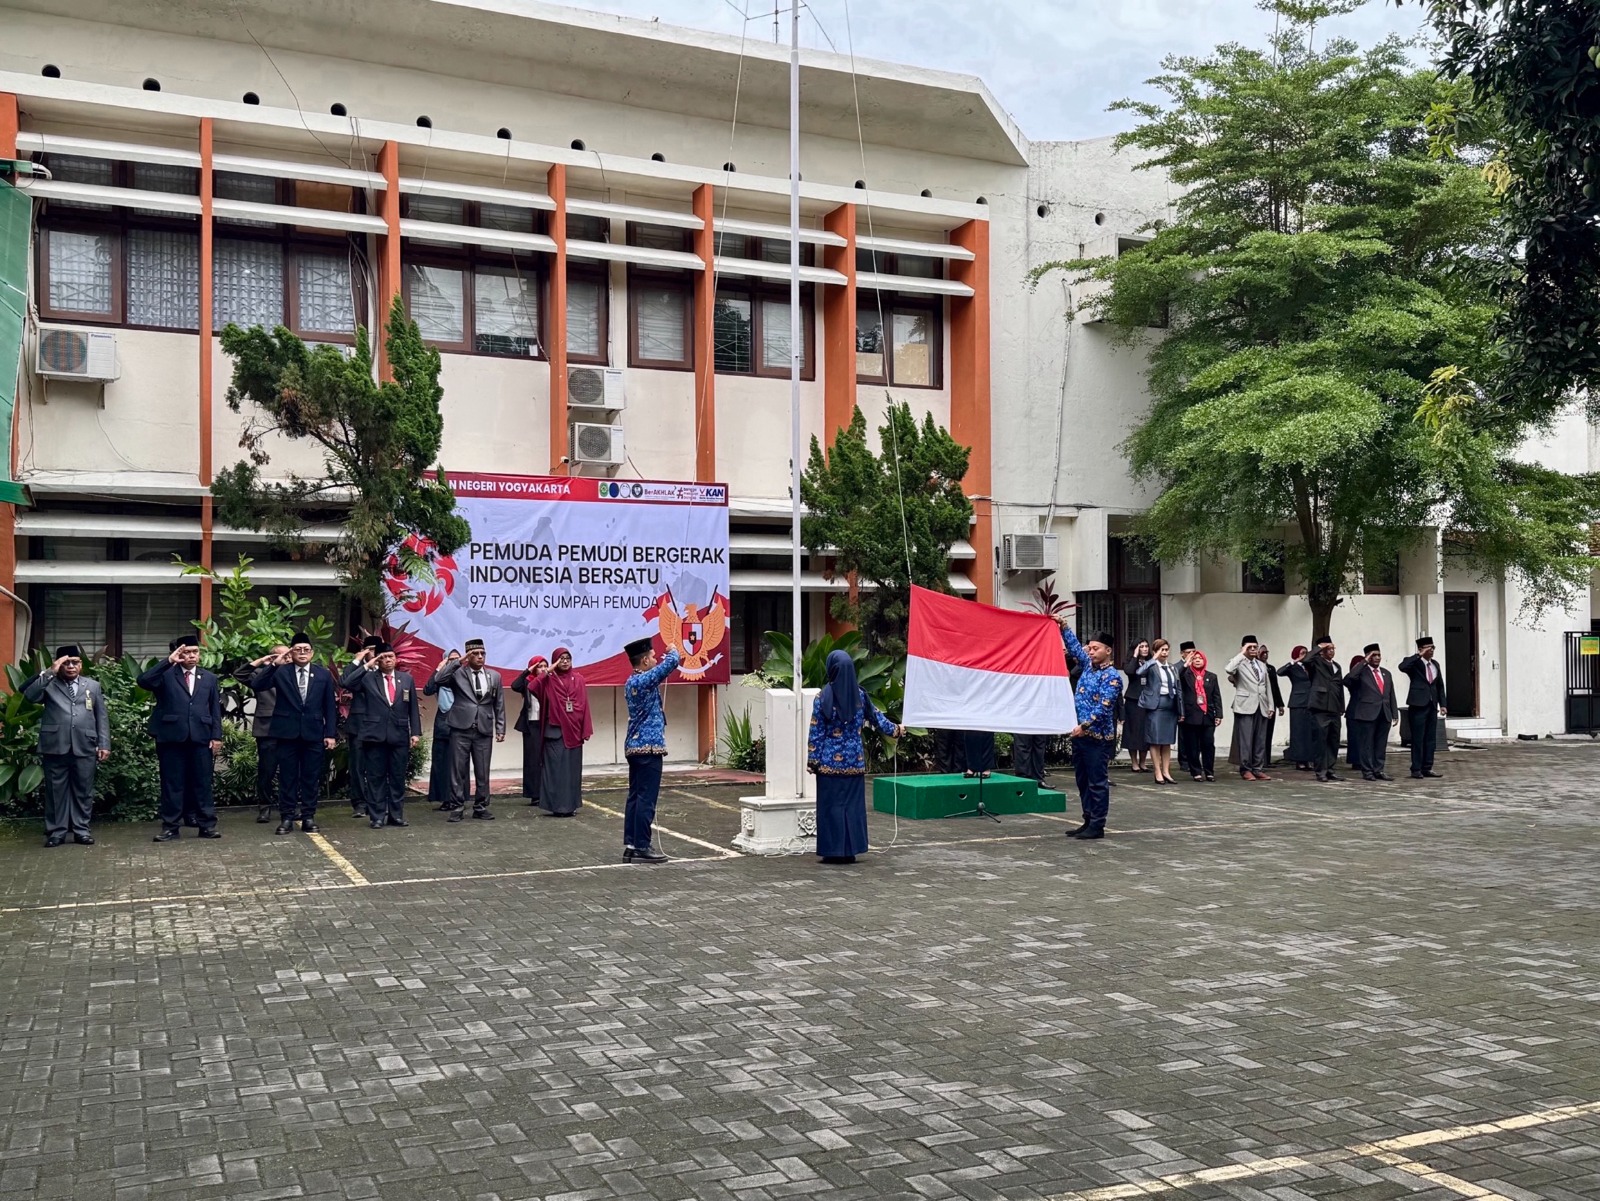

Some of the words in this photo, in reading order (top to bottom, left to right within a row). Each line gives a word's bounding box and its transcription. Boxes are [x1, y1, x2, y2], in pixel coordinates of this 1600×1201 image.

[459, 480, 496, 491] NEGERI
[499, 482, 571, 494] YOGYAKARTA
[705, 488, 724, 497] KAN
[470, 543, 552, 561] PEMUDA
[558, 545, 627, 562] PEMUDI
[633, 546, 725, 564] BERGERAK
[470, 566, 573, 584] INDONESIA
[579, 567, 659, 584] BERSATU
[470, 595, 487, 609] 97
[491, 595, 539, 609] TAHUN
[543, 595, 599, 609] SUMPAH
[603, 595, 659, 609] PEMUDA
